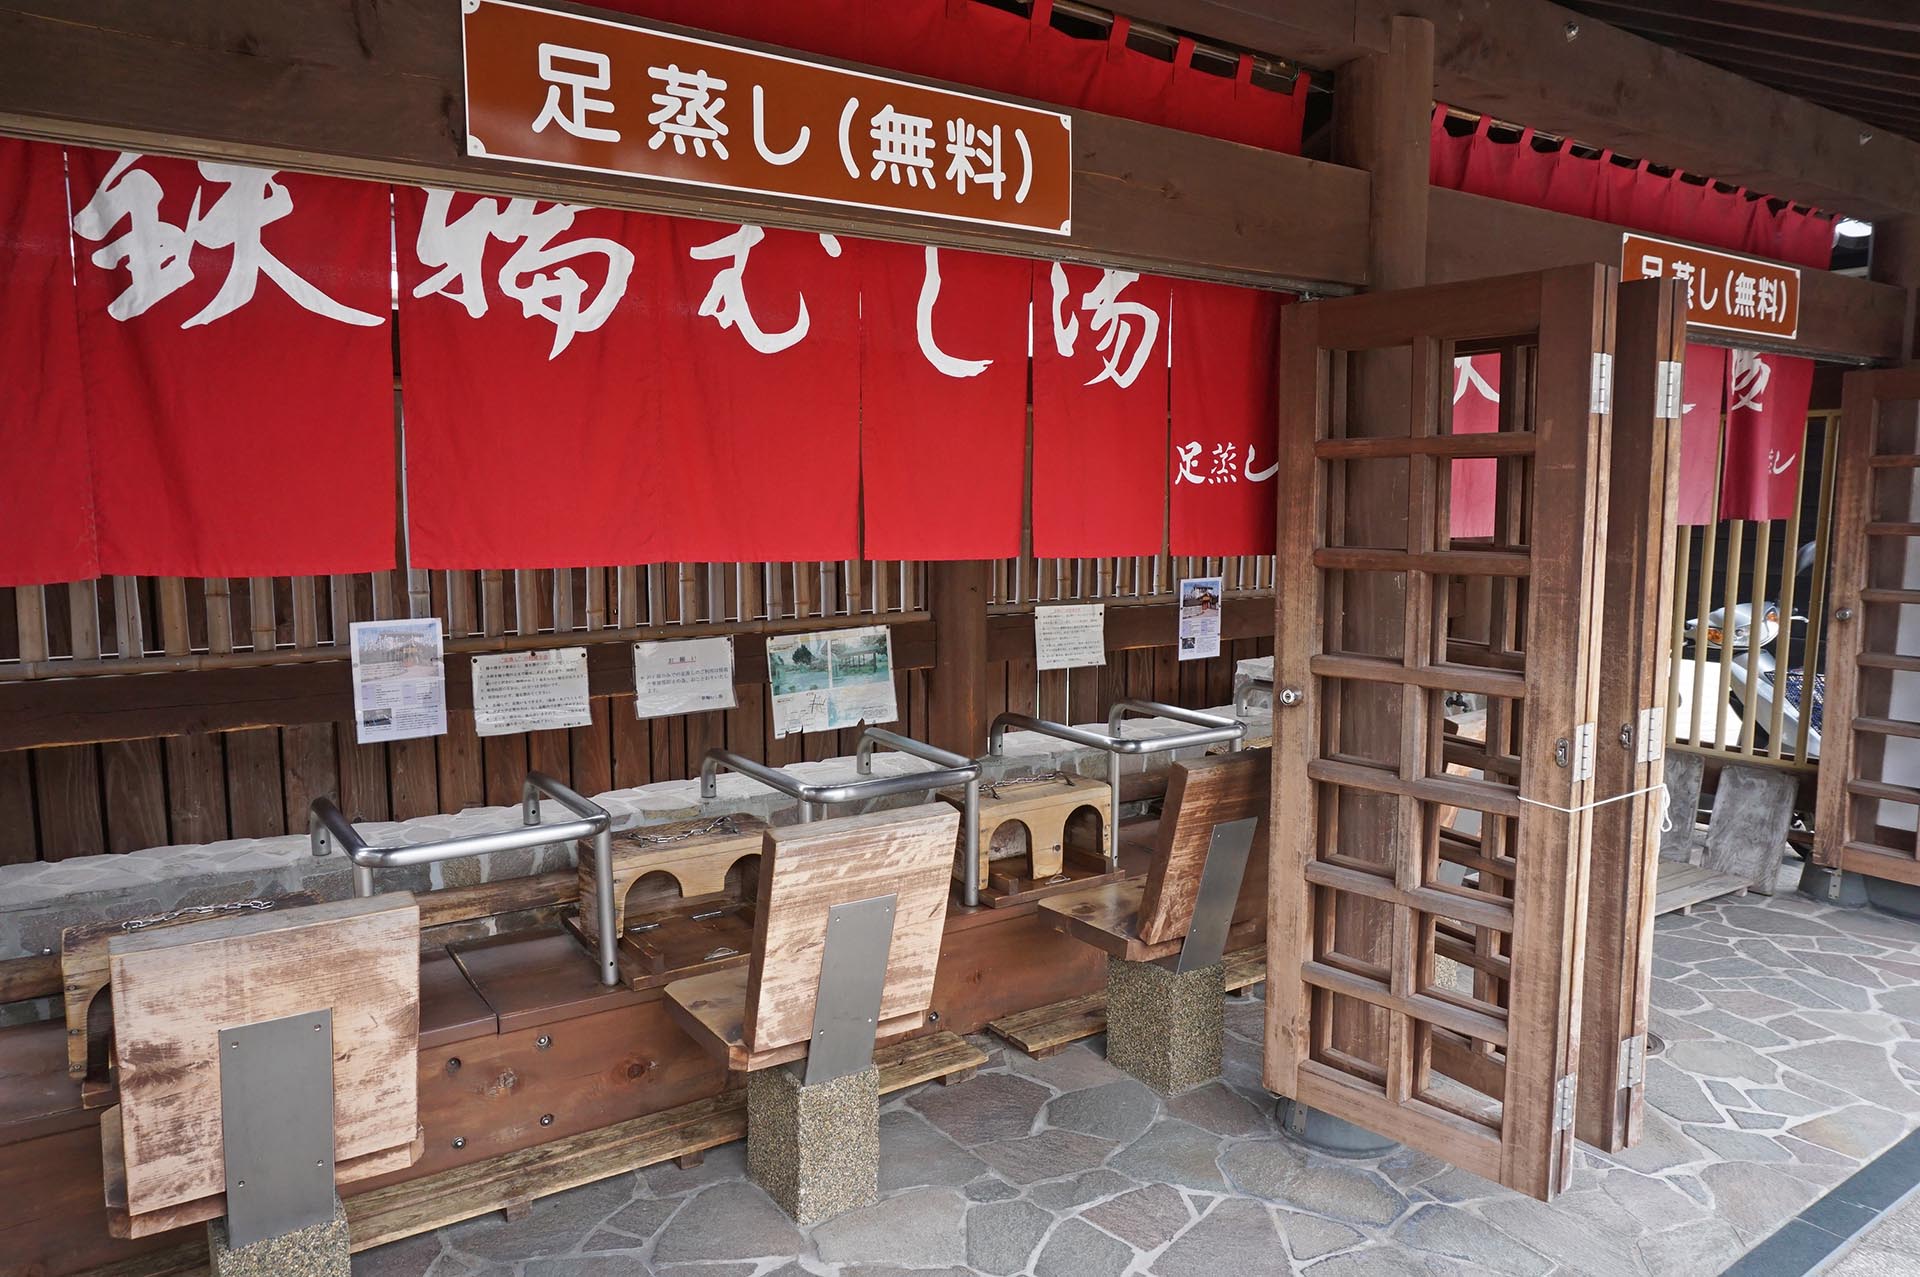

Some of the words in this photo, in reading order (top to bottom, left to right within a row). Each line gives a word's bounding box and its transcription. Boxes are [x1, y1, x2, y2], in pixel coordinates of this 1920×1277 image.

[532, 43, 1034, 204] 足蒸し(無料)
[1174, 441, 1279, 485] 足蒸し
